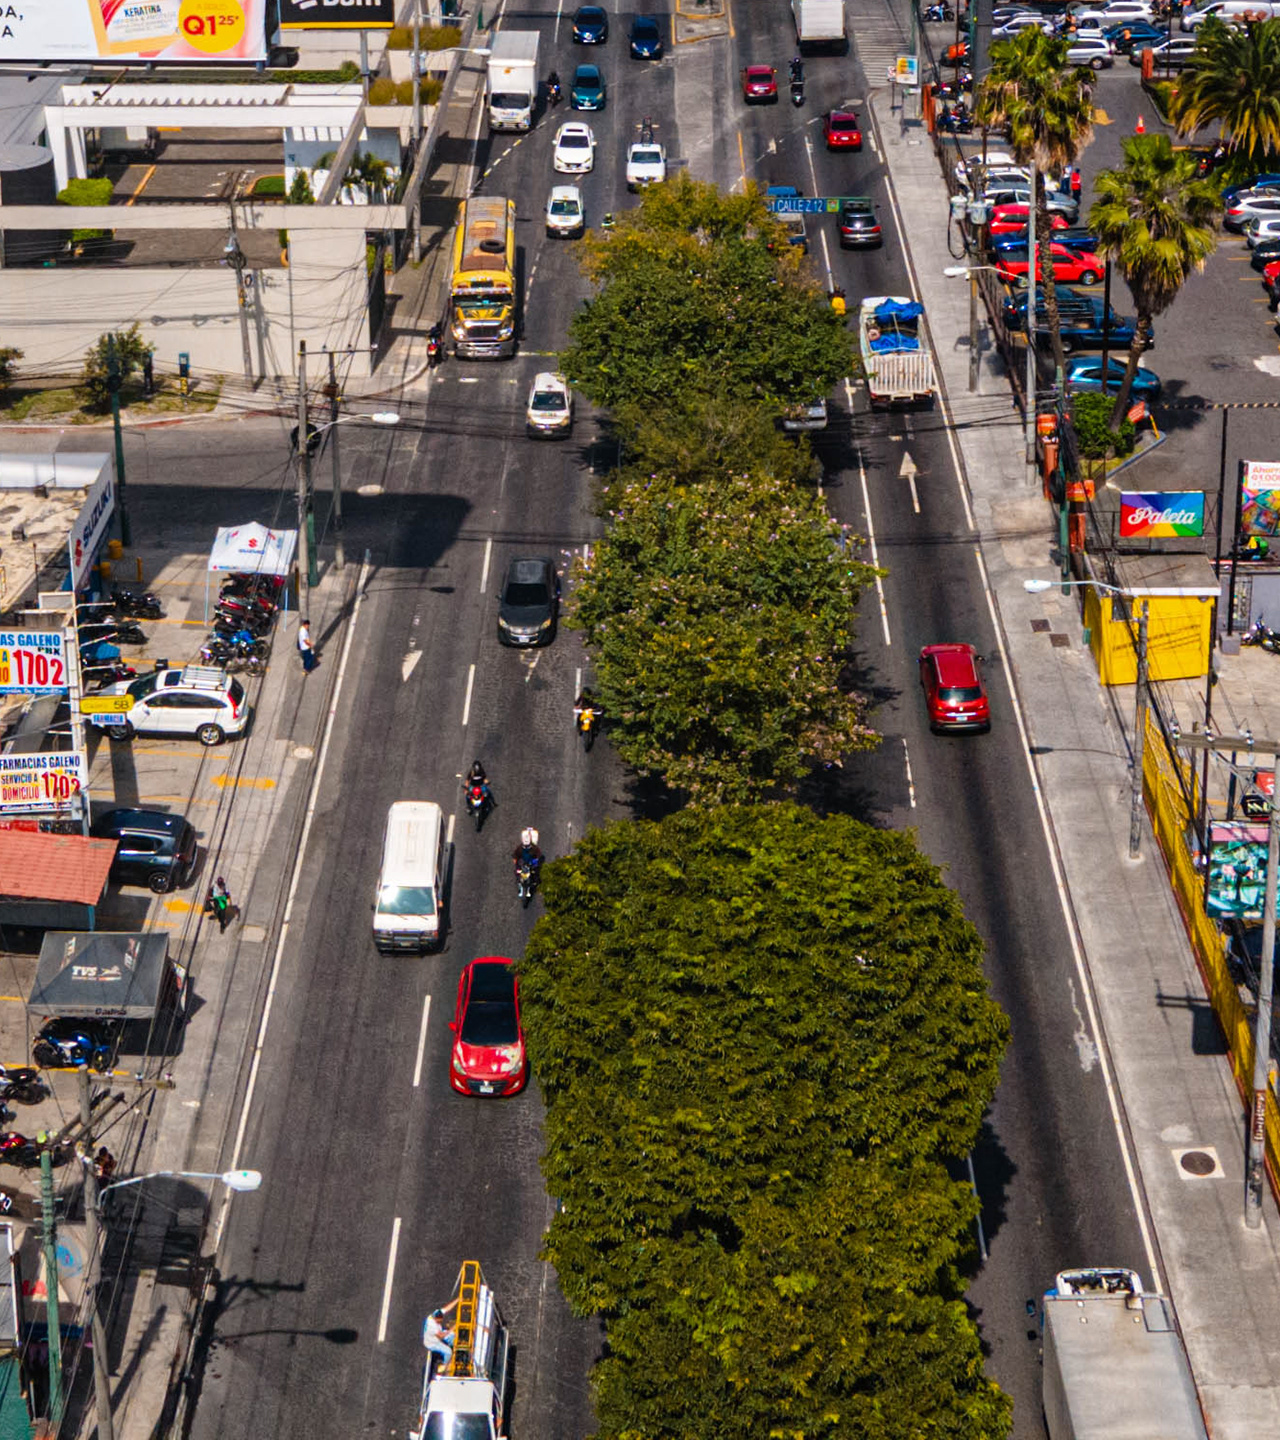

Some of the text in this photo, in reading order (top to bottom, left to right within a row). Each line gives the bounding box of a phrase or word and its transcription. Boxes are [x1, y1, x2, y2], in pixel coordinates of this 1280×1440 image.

[777, 200, 803, 212] CALLE
[1128, 506, 1197, 525] Paleta
[17, 633, 60, 647] GALENO
[1, 650, 8, 662] A
[12, 649, 64, 686] 1702
[48, 755, 81, 768] GALENO
[0, 773, 38, 785] SERVICIO A
[2, 786, 40, 801] DOMICILIO
[72, 965, 98, 976] TVS
